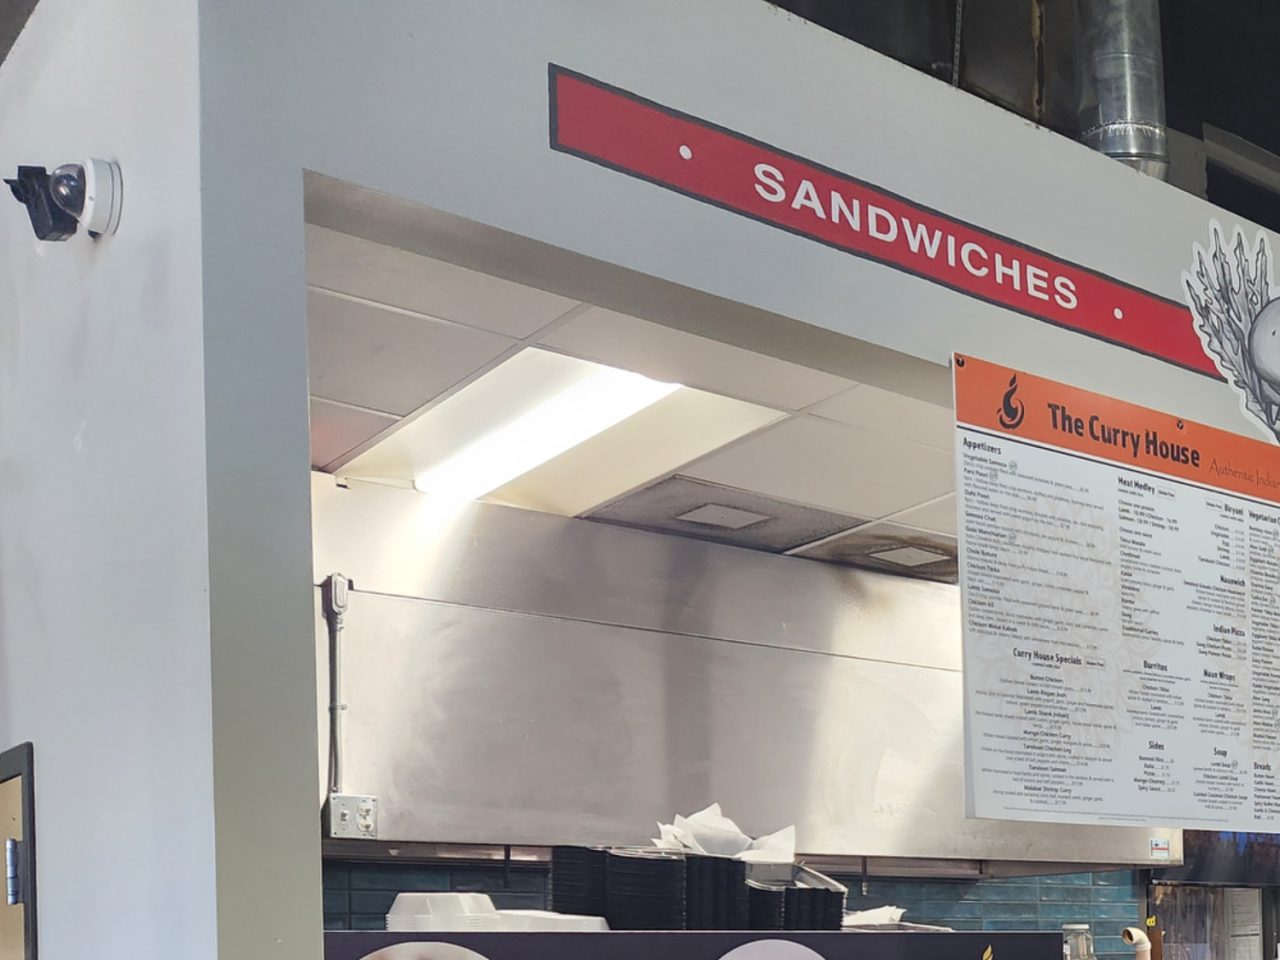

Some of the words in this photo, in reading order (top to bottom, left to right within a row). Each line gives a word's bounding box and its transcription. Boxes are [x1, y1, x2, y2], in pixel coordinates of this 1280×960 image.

[753, 162, 1079, 309] SANDWICHES
[963, 437, 1001, 454] Appetizers
[1047, 403, 1084, 437] The
[1088, 414, 1141, 457] Curry
[1145, 430, 1200, 467] House
[1209, 458, 1255, 485] Authentic
[1231, 626, 1245, 637] Pizza
[1013, 648, 1031, 660] Curry
[1033, 651, 1054, 661] House
[1056, 653, 1082, 665] Specials
[1144, 661, 1167, 672] Burritos
[1149, 741, 1164, 750] Sides
[1214, 747, 1227, 757] Soup
